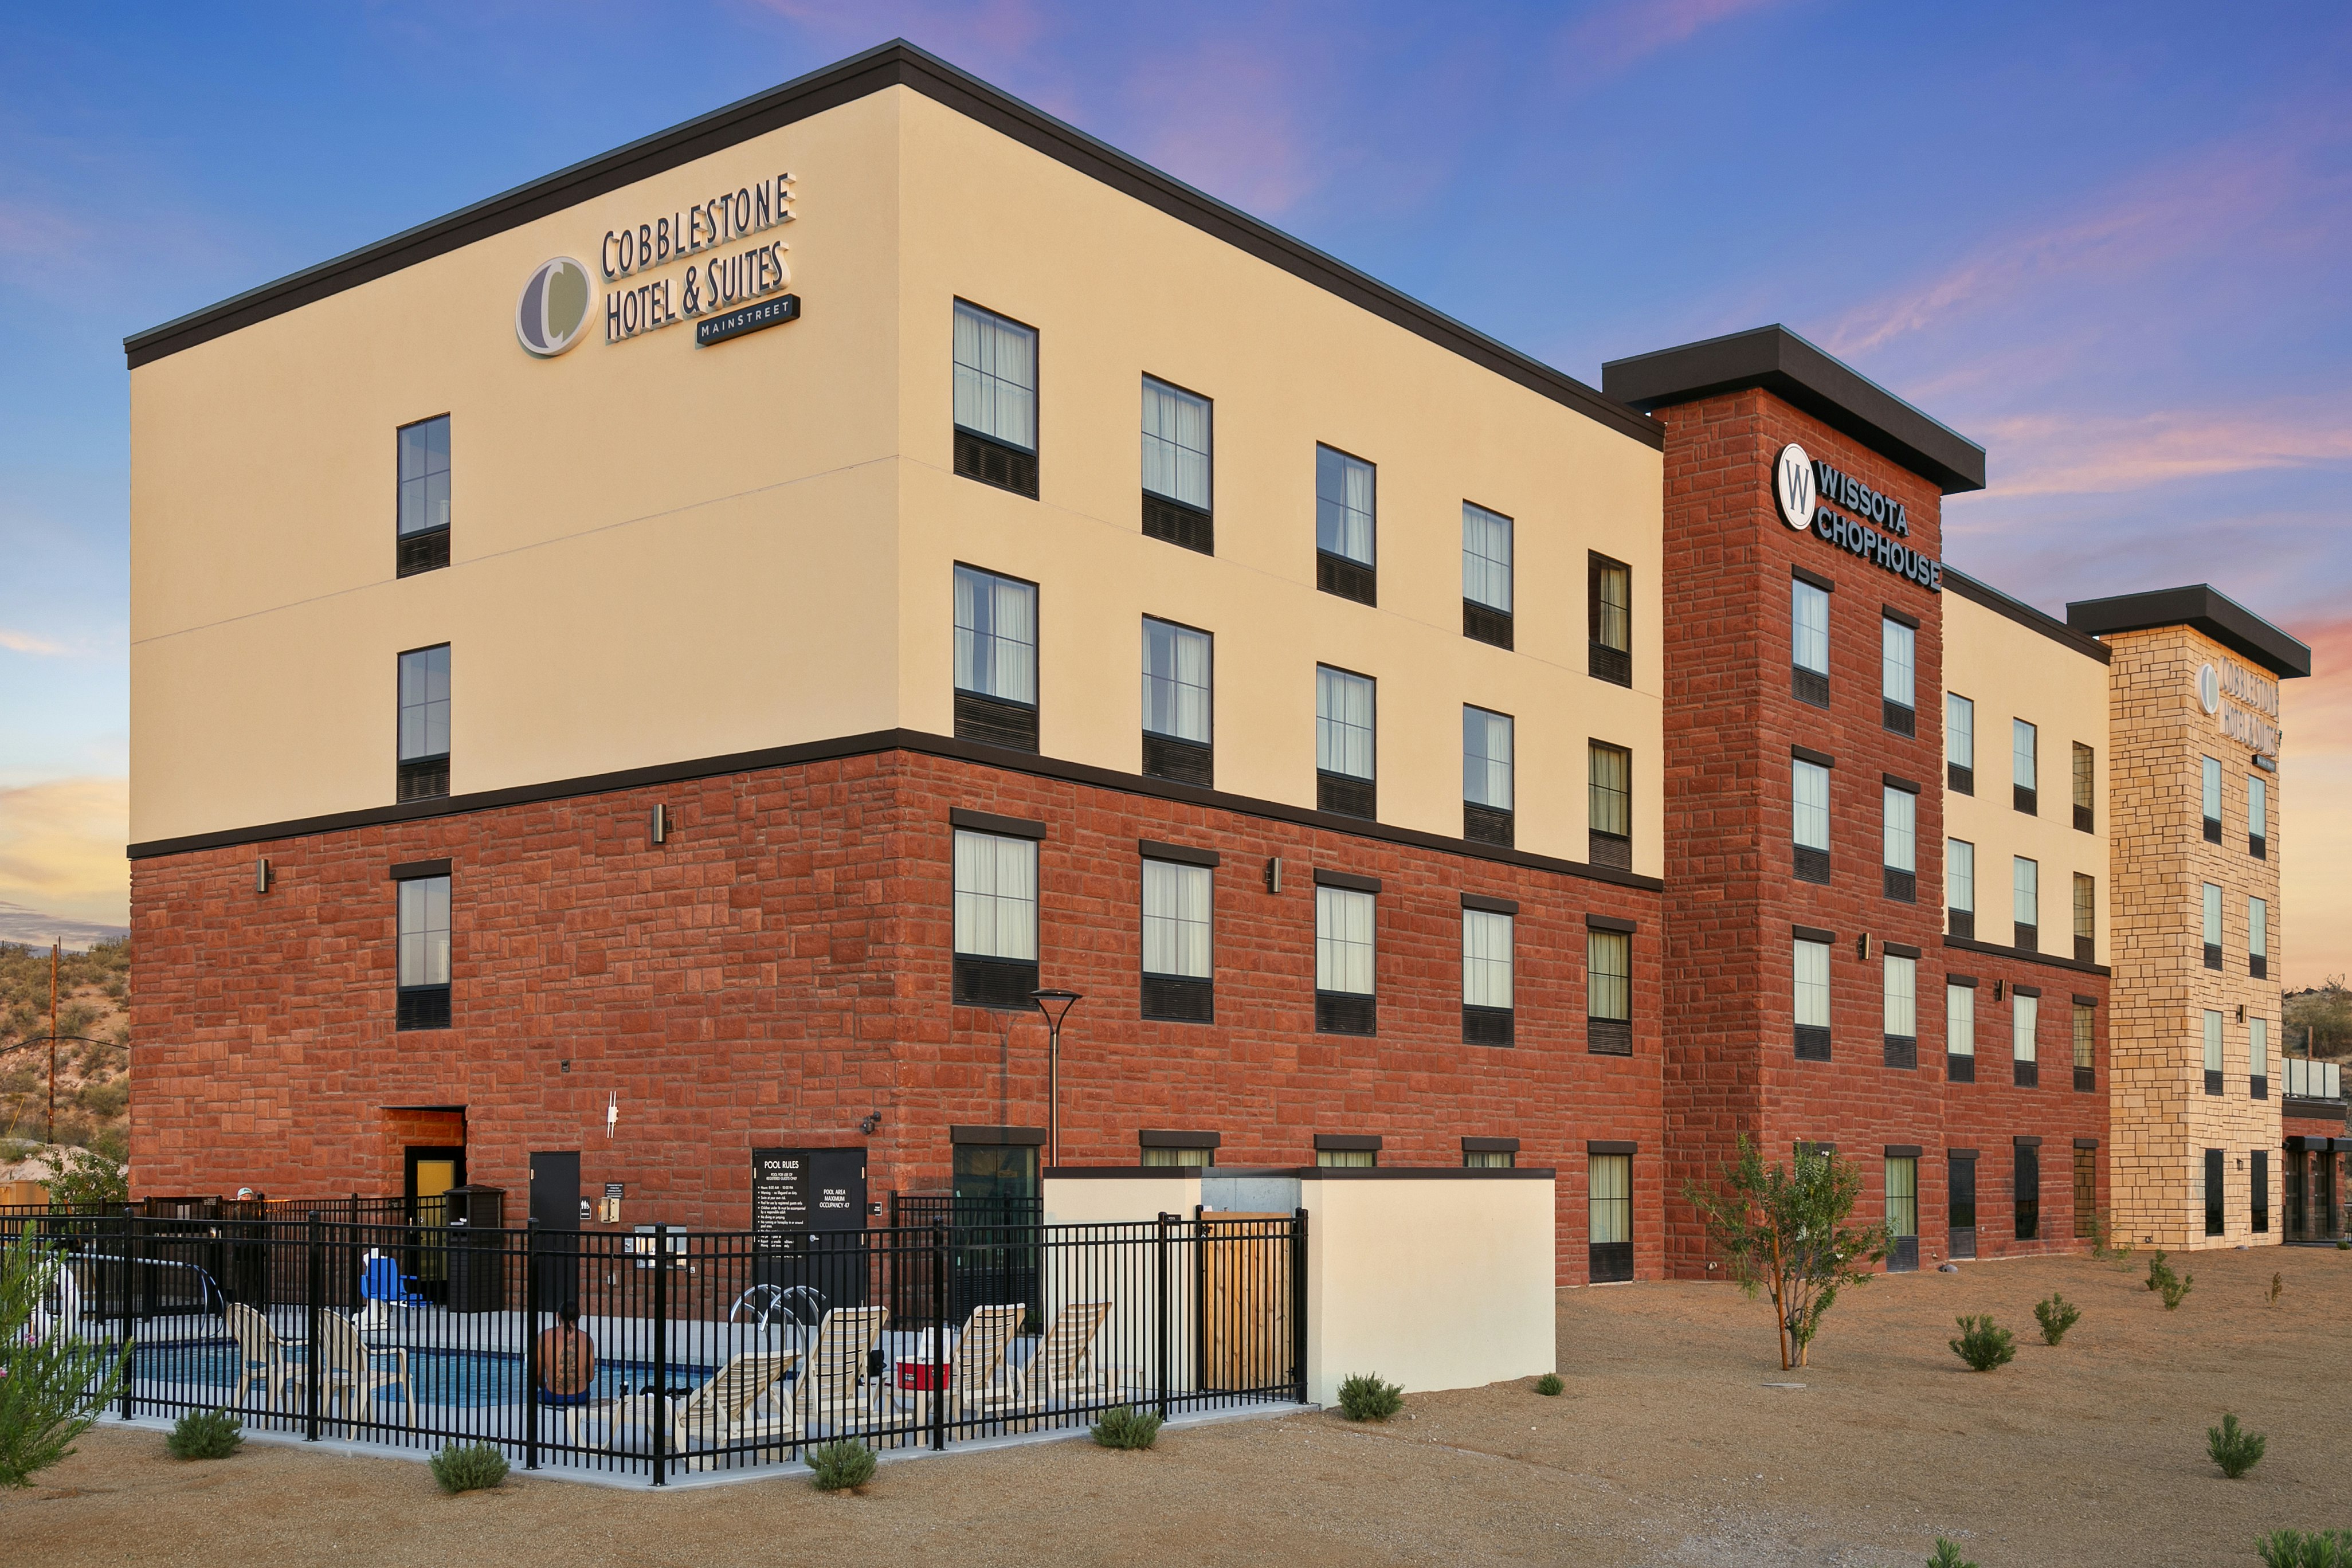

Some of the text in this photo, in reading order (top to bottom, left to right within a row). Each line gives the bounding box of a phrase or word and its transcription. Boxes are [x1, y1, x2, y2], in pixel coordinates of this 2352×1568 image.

[602, 173, 796, 281] COBBLESTONE
[606, 241, 790, 342] HOTEL & SUITES
[701, 301, 790, 338] MAINSTREET
[1785, 458, 1810, 515] W
[1817, 460, 1910, 537] WISSOTA
[1817, 505, 1942, 593] CHOPHOUSE
